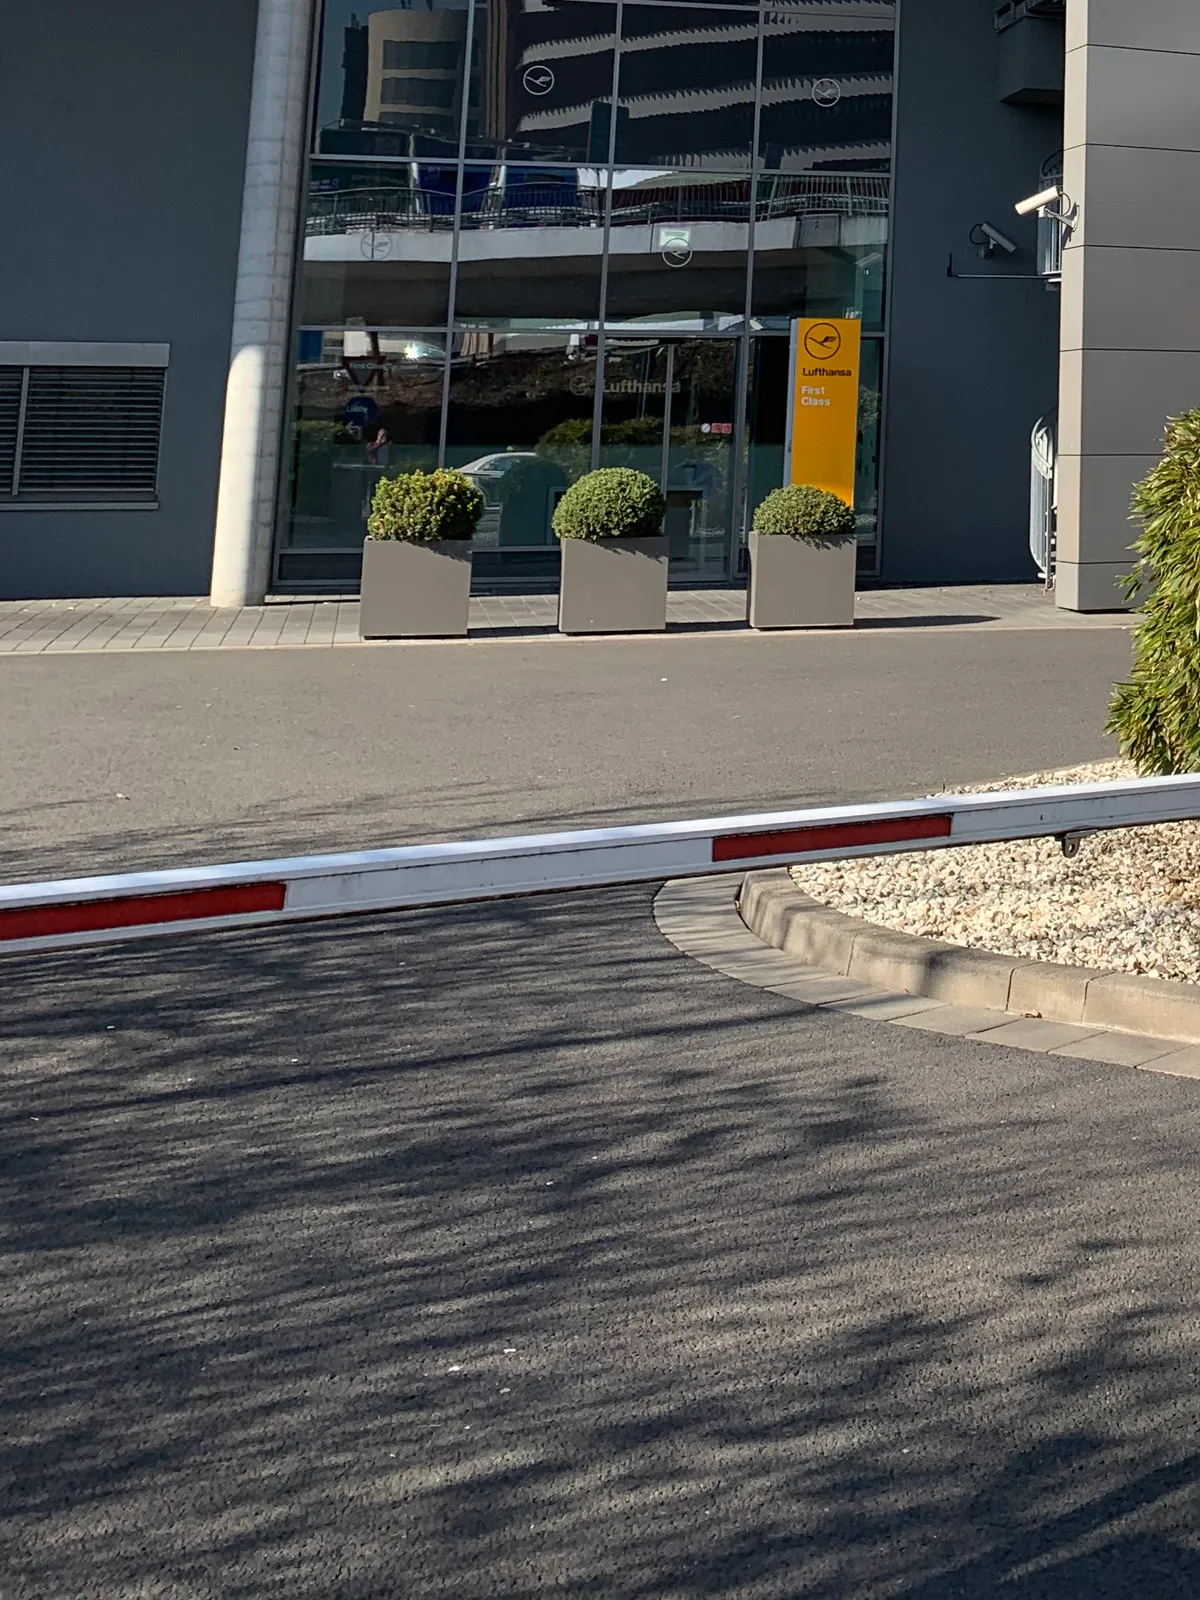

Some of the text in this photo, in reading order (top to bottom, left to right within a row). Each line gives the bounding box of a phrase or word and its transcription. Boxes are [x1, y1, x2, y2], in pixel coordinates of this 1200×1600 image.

[802, 367, 852, 377] Lufthansa
[801, 385, 825, 395] First
[801, 396, 831, 406] Class
